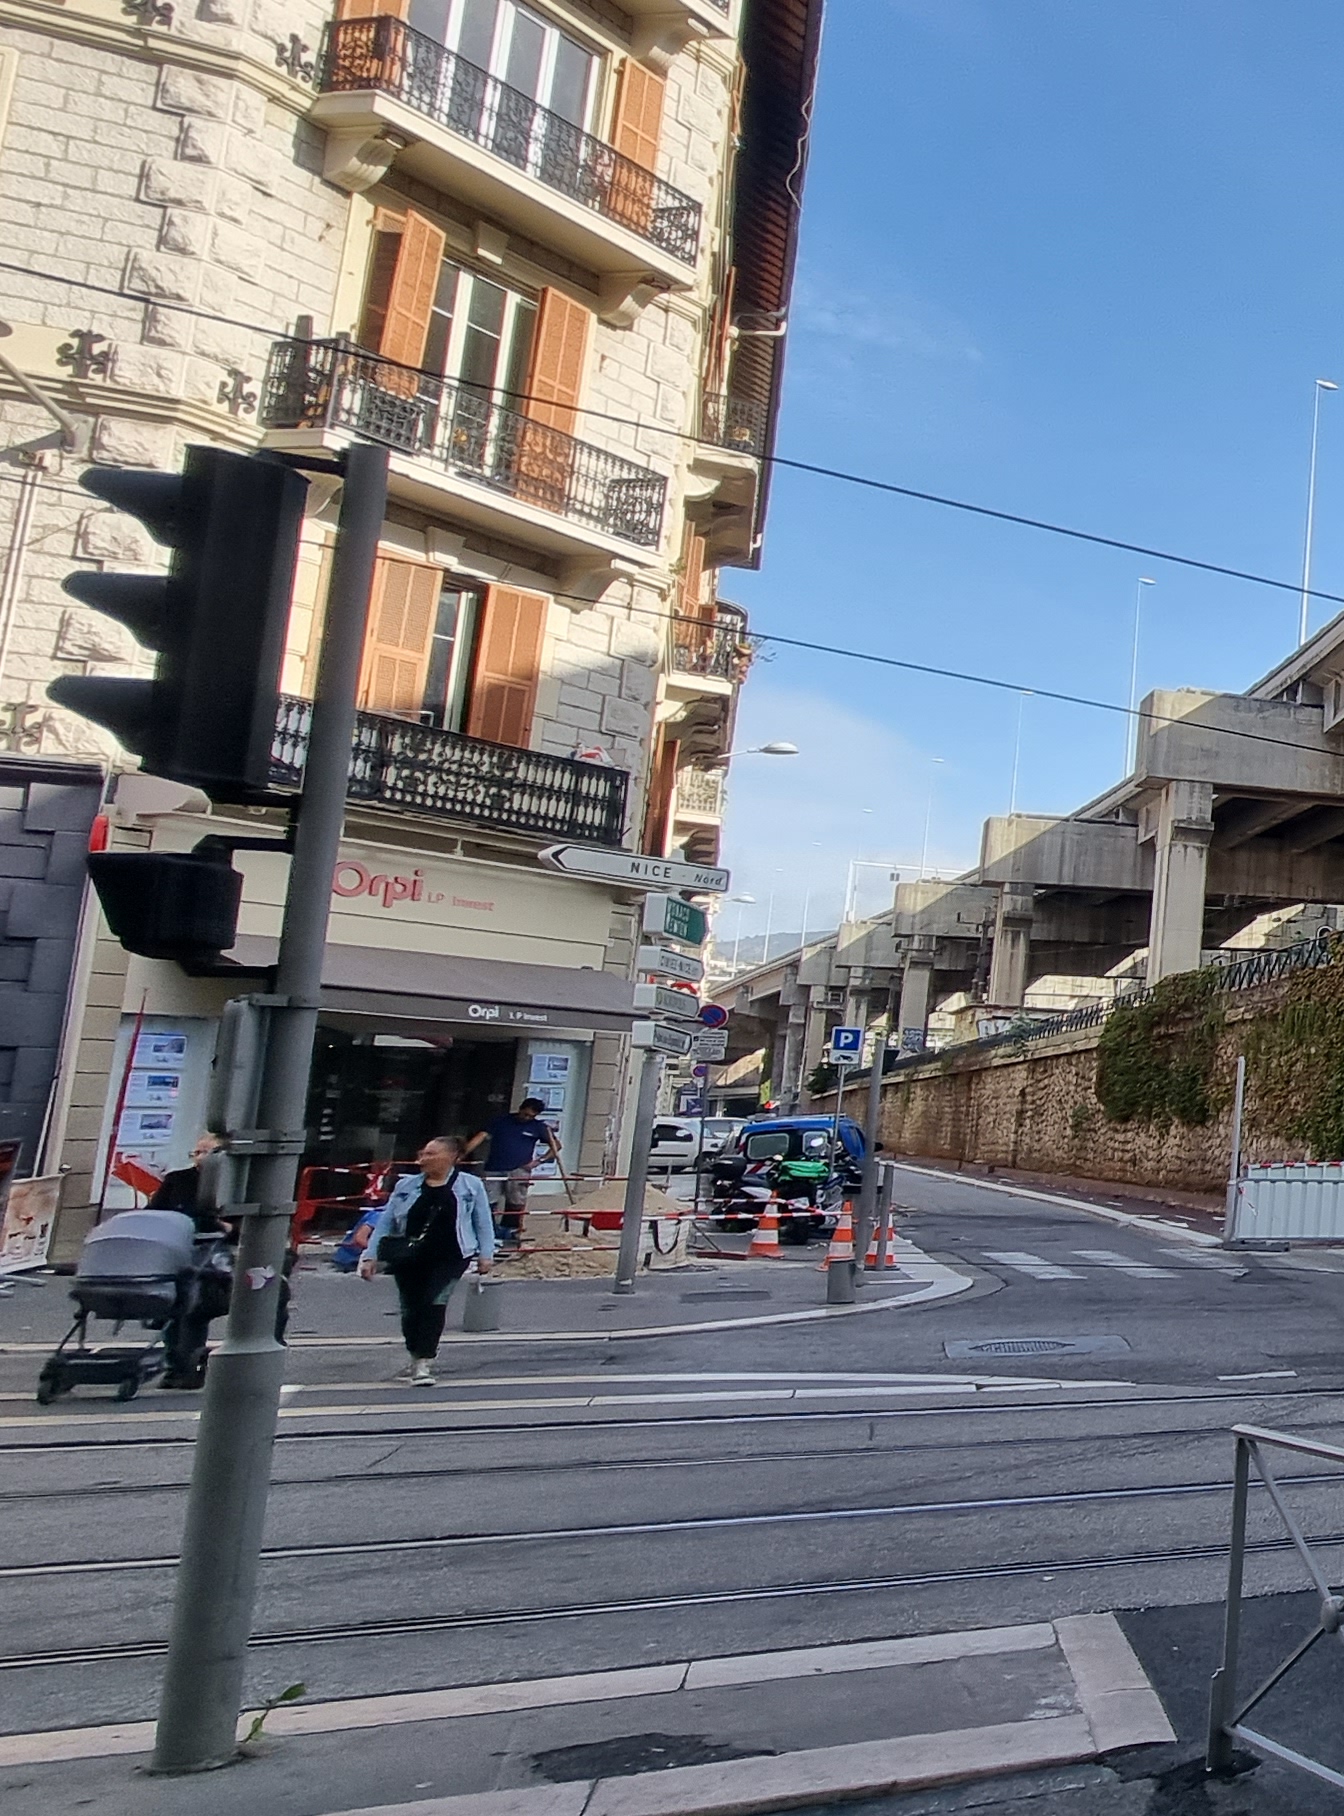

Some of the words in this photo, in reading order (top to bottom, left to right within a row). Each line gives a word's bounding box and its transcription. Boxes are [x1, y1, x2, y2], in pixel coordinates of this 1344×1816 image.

[332, 861, 424, 908] Orpi
[630, 862, 672, 879] NICE
[693, 873, 724, 887] Nord
[468, 1005, 500, 1020] Orpi
[840, 1032, 854, 1047] P
